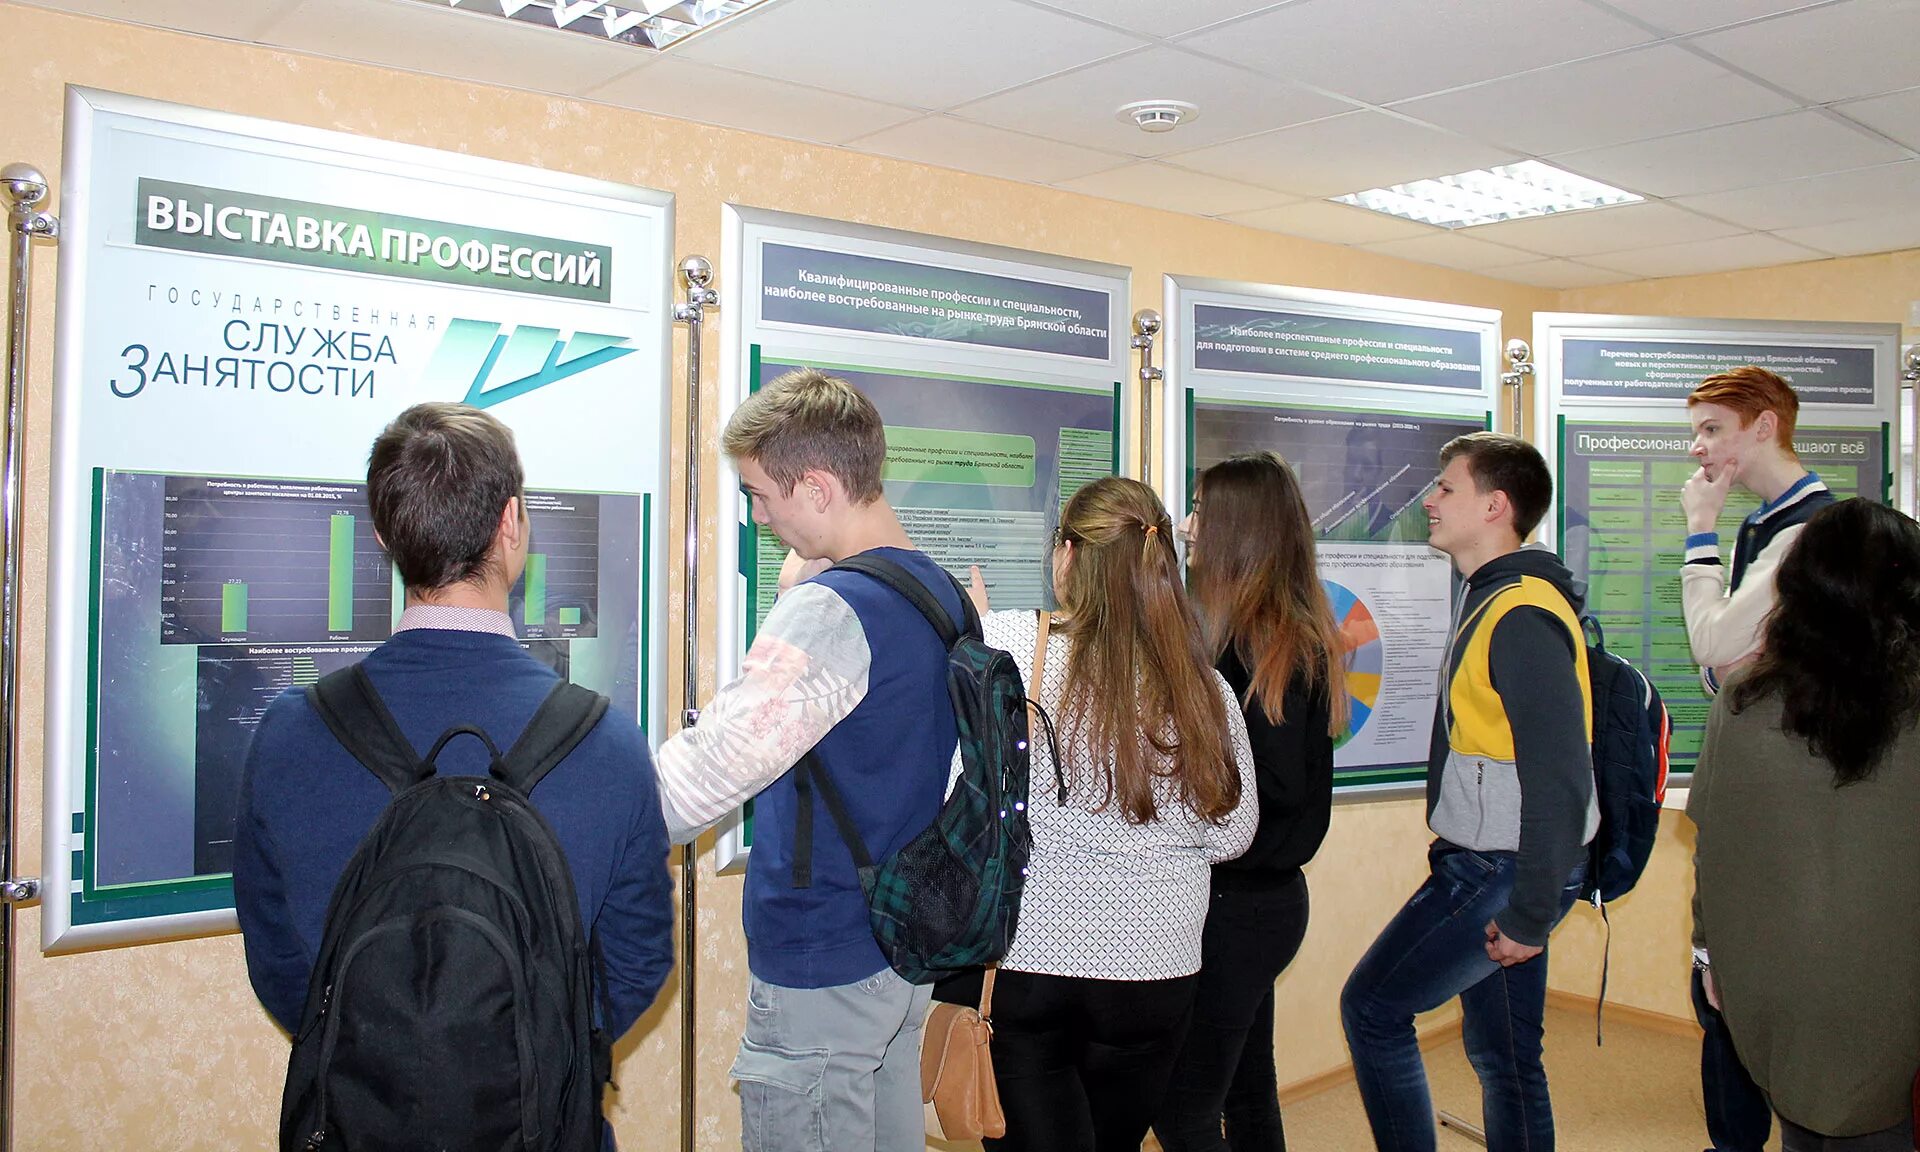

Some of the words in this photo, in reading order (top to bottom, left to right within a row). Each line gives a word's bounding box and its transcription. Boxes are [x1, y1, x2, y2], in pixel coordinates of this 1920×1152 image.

[147, 195, 374, 258] ВЫСТАВКА
[381, 226, 601, 288] ПРОФЕССИЙ
[148, 284, 436, 330] ГОСУДАРСТВЕННАЯ
[798, 269, 929, 298] Квалифицированные
[931, 289, 992, 307] профессии
[993, 297, 1001, 307] и
[1002, 299, 1082, 320] специальности,
[764, 285, 826, 303] наиболее
[828, 294, 929, 315] востребованные
[931, 307, 945, 318] на
[947, 309, 983, 323] рынке
[984, 313, 1015, 327] труда
[1017, 316, 1066, 333] Брянской
[1067, 323, 1107, 338] области
[223, 319, 397, 364] СЛУЖБА
[1230, 326, 1274, 339] Наиболее
[1275, 331, 1341, 345] перспективные
[1342, 337, 1387, 349] профессии
[1394, 343, 1453, 355] специальности
[1196, 341, 1213, 350] для
[1215, 342, 1267, 353] подготовки
[1274, 348, 1310, 358] системе
[1311, 351, 1349, 361] среднего
[1350, 353, 1430, 368] профессионального
[1430, 360, 1481, 372] образования
[1600, 349, 1639, 358] Перечень
[1640, 351, 1706, 360] востребованных
[1717, 354, 1743, 362] рынке
[1743, 355, 1766, 363] труда
[1767, 355, 1803, 364] Брянской
[1648, 362, 1709, 370] перспективных
[1564, 378, 1613, 387] полученных
[1624, 379, 1684, 388] работодателей
[1792, 442, 1837, 454] ешают
[1840, 441, 1865, 454] всё
[954, 460, 974, 468] труда
[249, 647, 283, 655] Наиболее
[284, 646, 340, 655] востребованные
